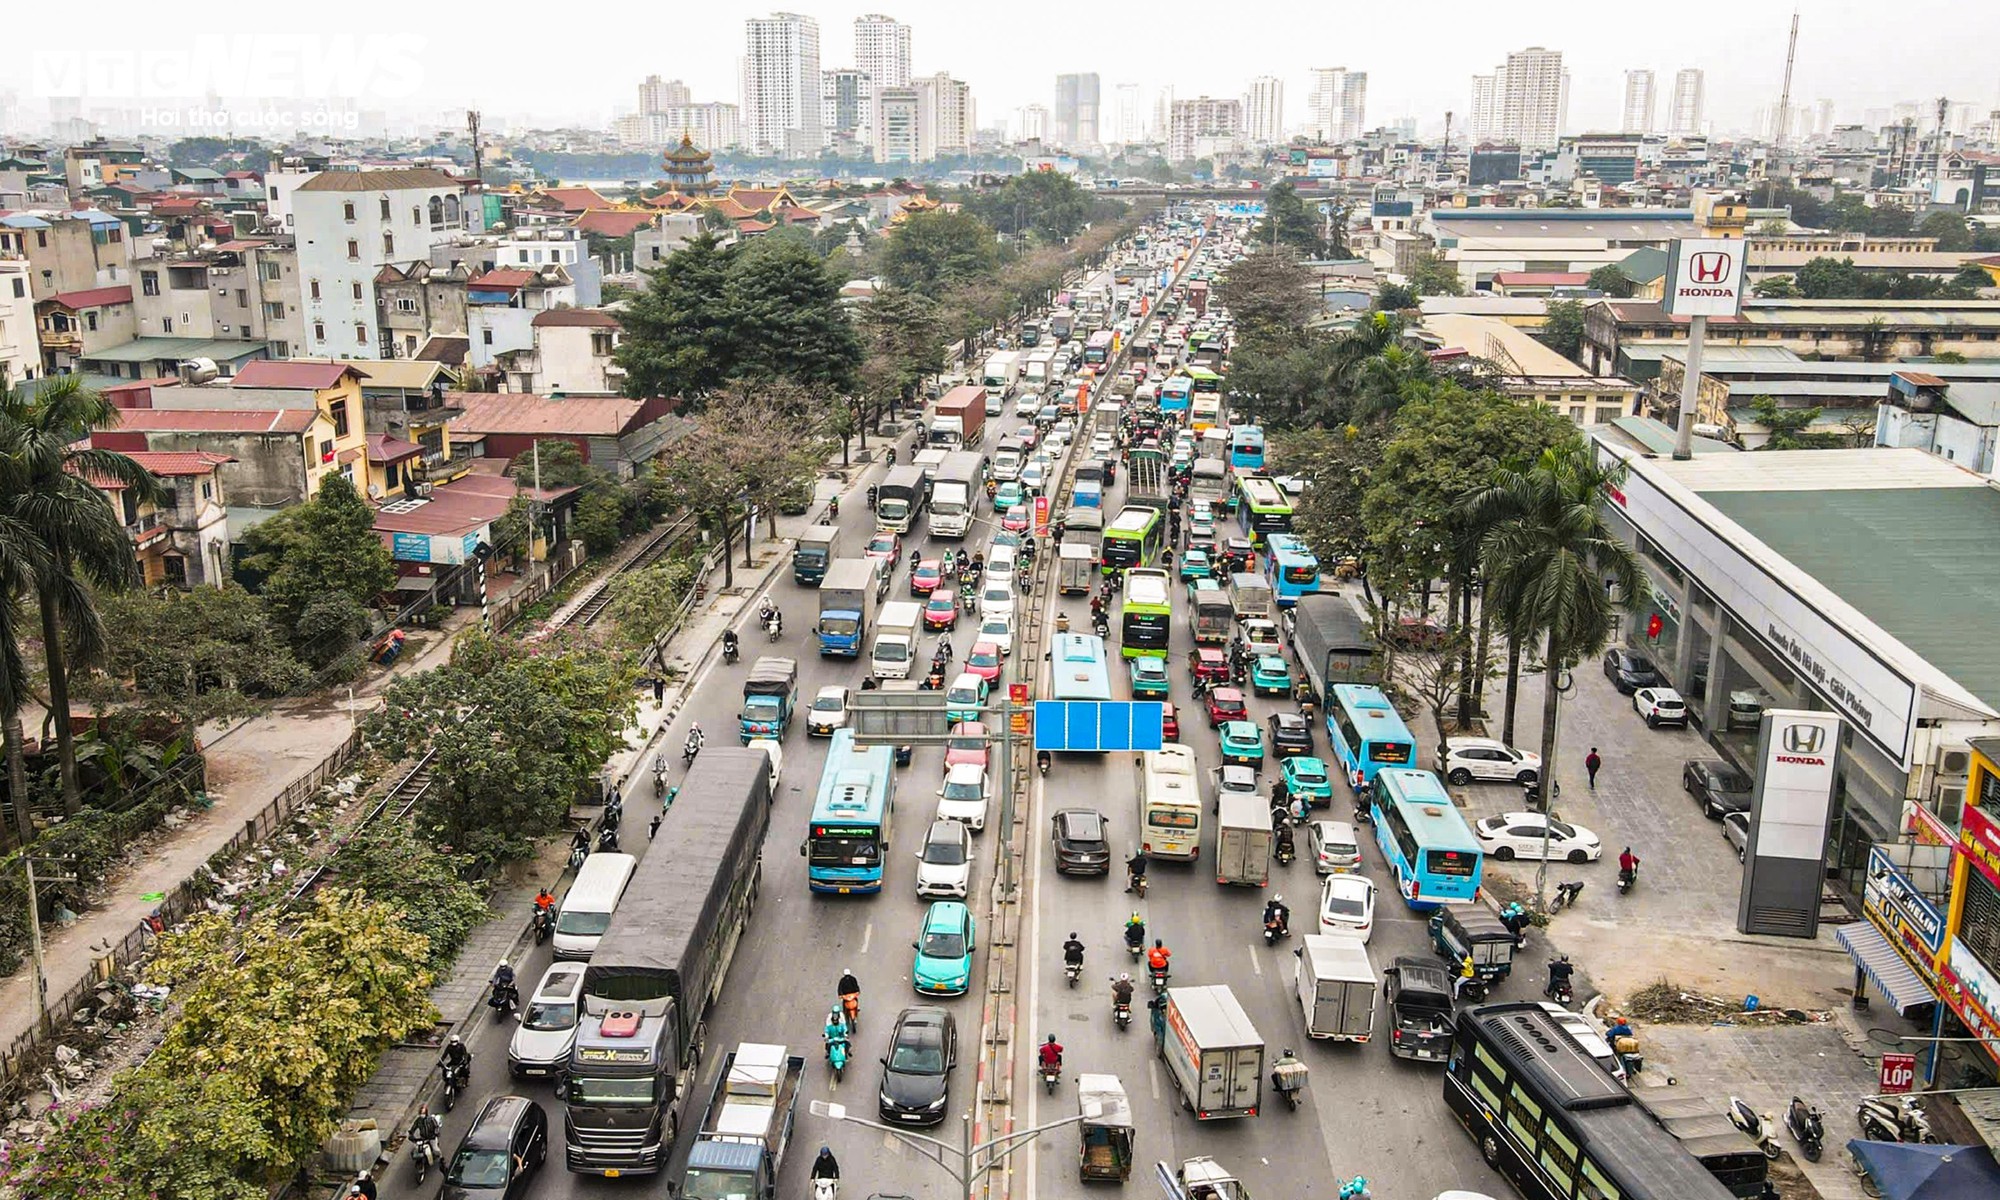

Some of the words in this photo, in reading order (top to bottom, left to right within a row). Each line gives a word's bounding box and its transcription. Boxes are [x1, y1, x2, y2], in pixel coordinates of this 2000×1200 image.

[1679, 288, 1734, 298] HONDA
[1768, 623, 1789, 651] Honda
[1846, 690, 1873, 728] Phóng
[1777, 756, 1826, 766] HONDA
[1883, 1063, 1913, 1086] LỐP
